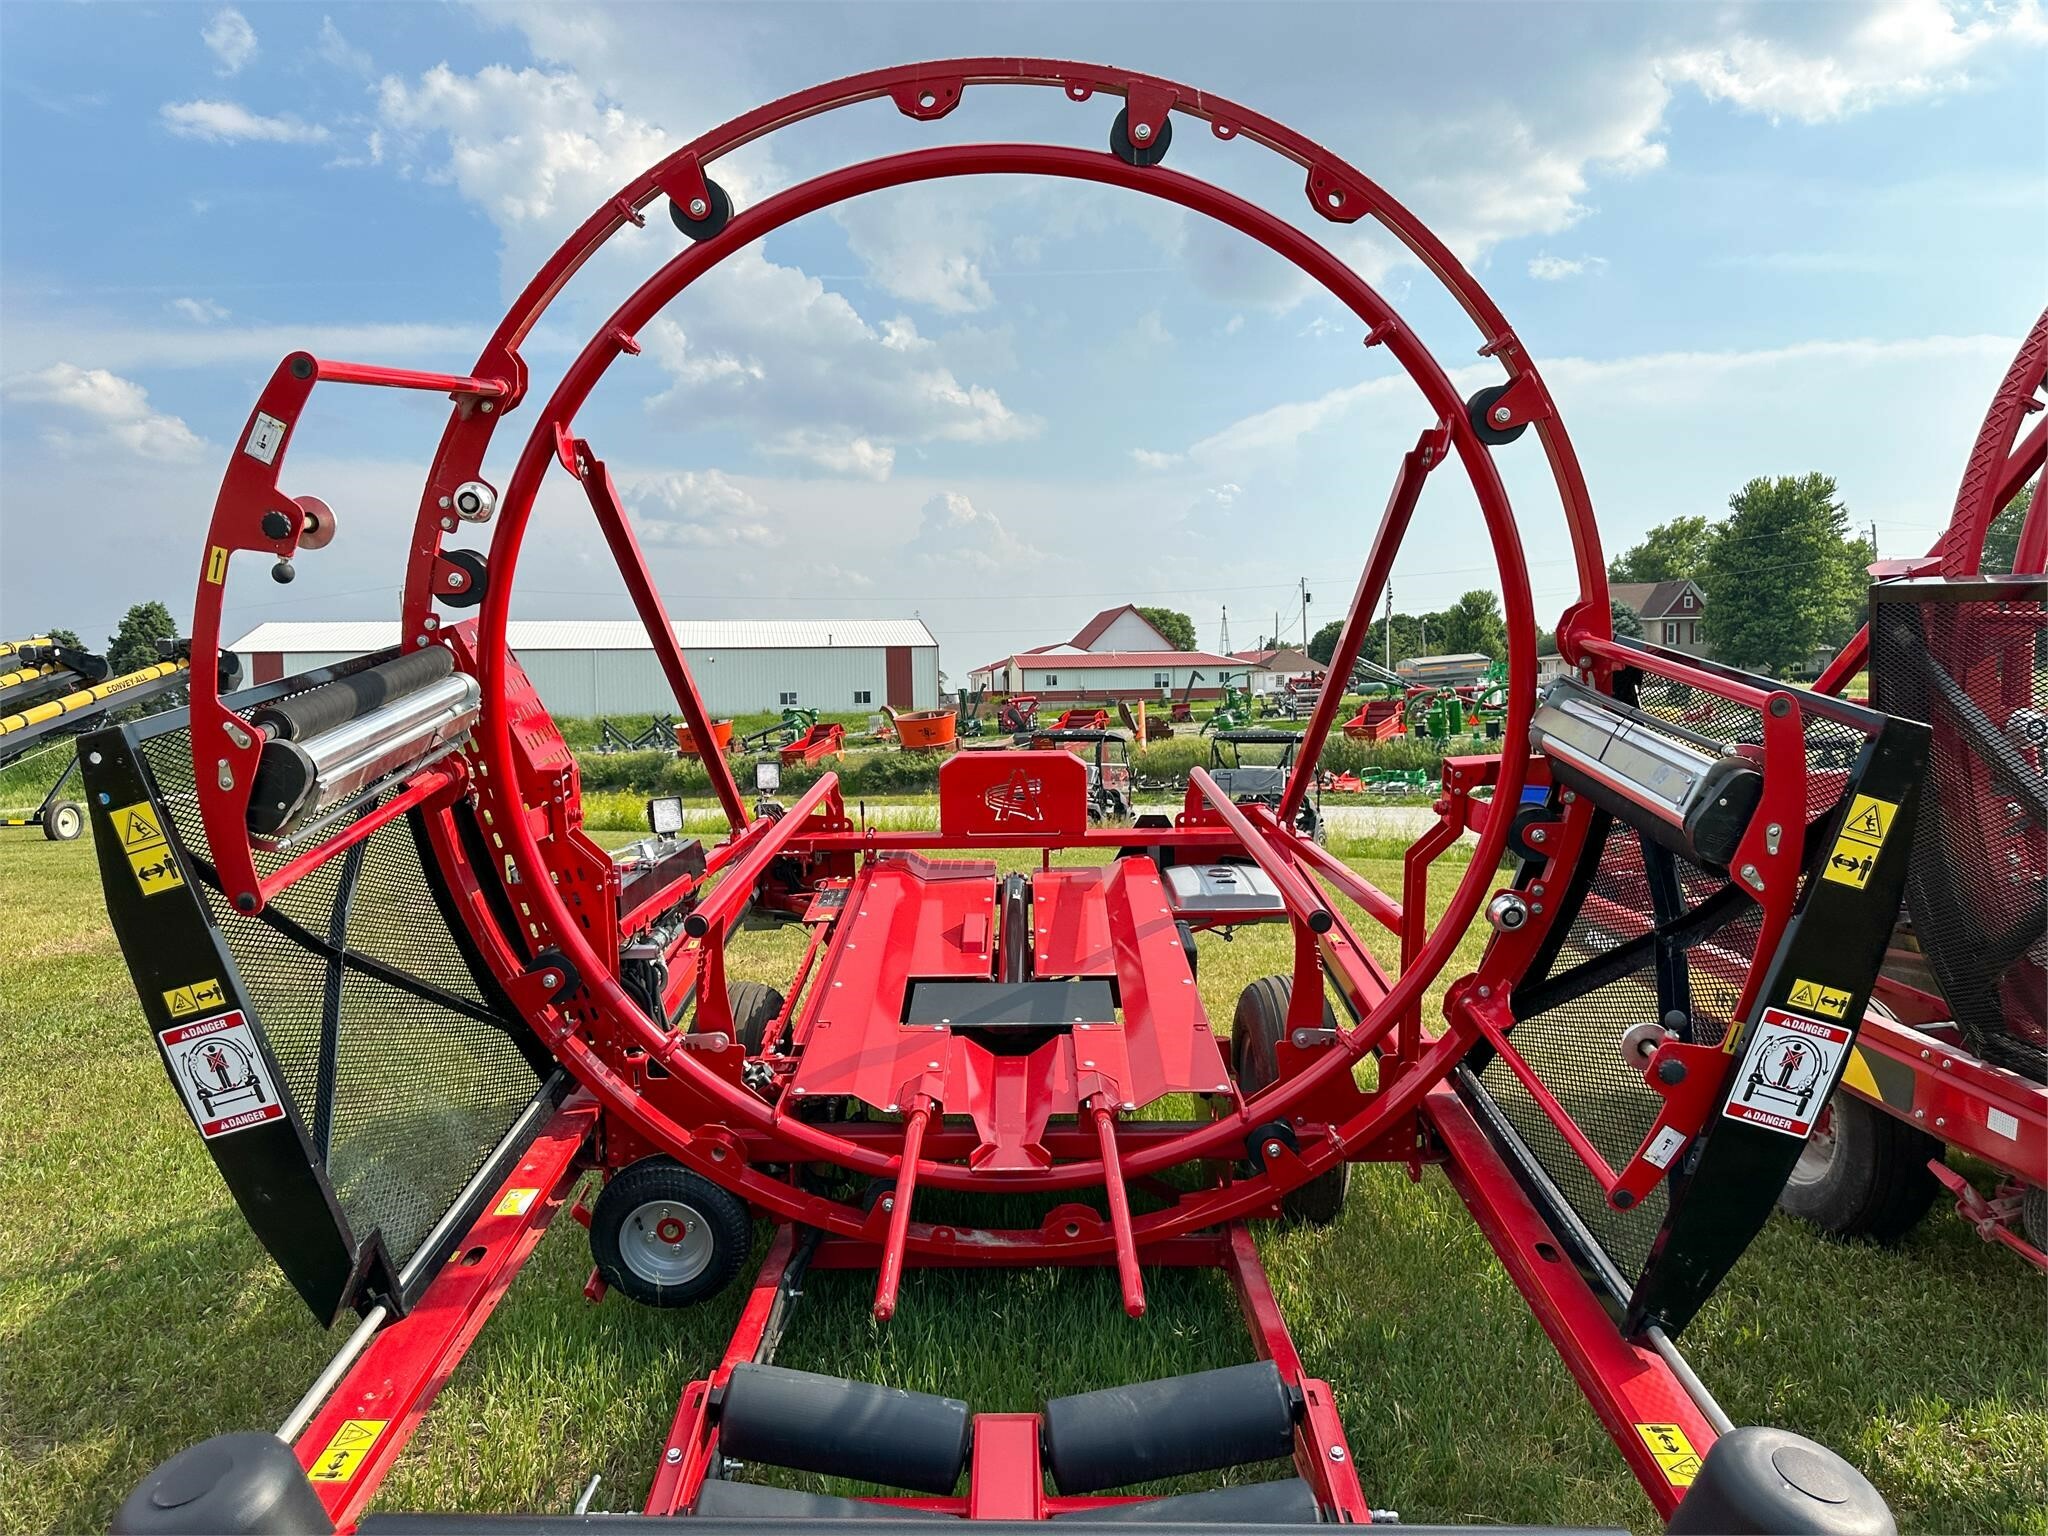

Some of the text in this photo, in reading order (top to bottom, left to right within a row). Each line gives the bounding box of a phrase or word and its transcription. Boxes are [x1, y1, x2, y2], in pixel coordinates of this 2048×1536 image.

[106, 673, 148, 694] CONVEY-ALL
[188, 1019, 228, 1037] DANGER
[1790, 1019, 1831, 1038] DANGER
[227, 1110, 267, 1127] DANGER
[1752, 1112, 1792, 1130] DANGER
